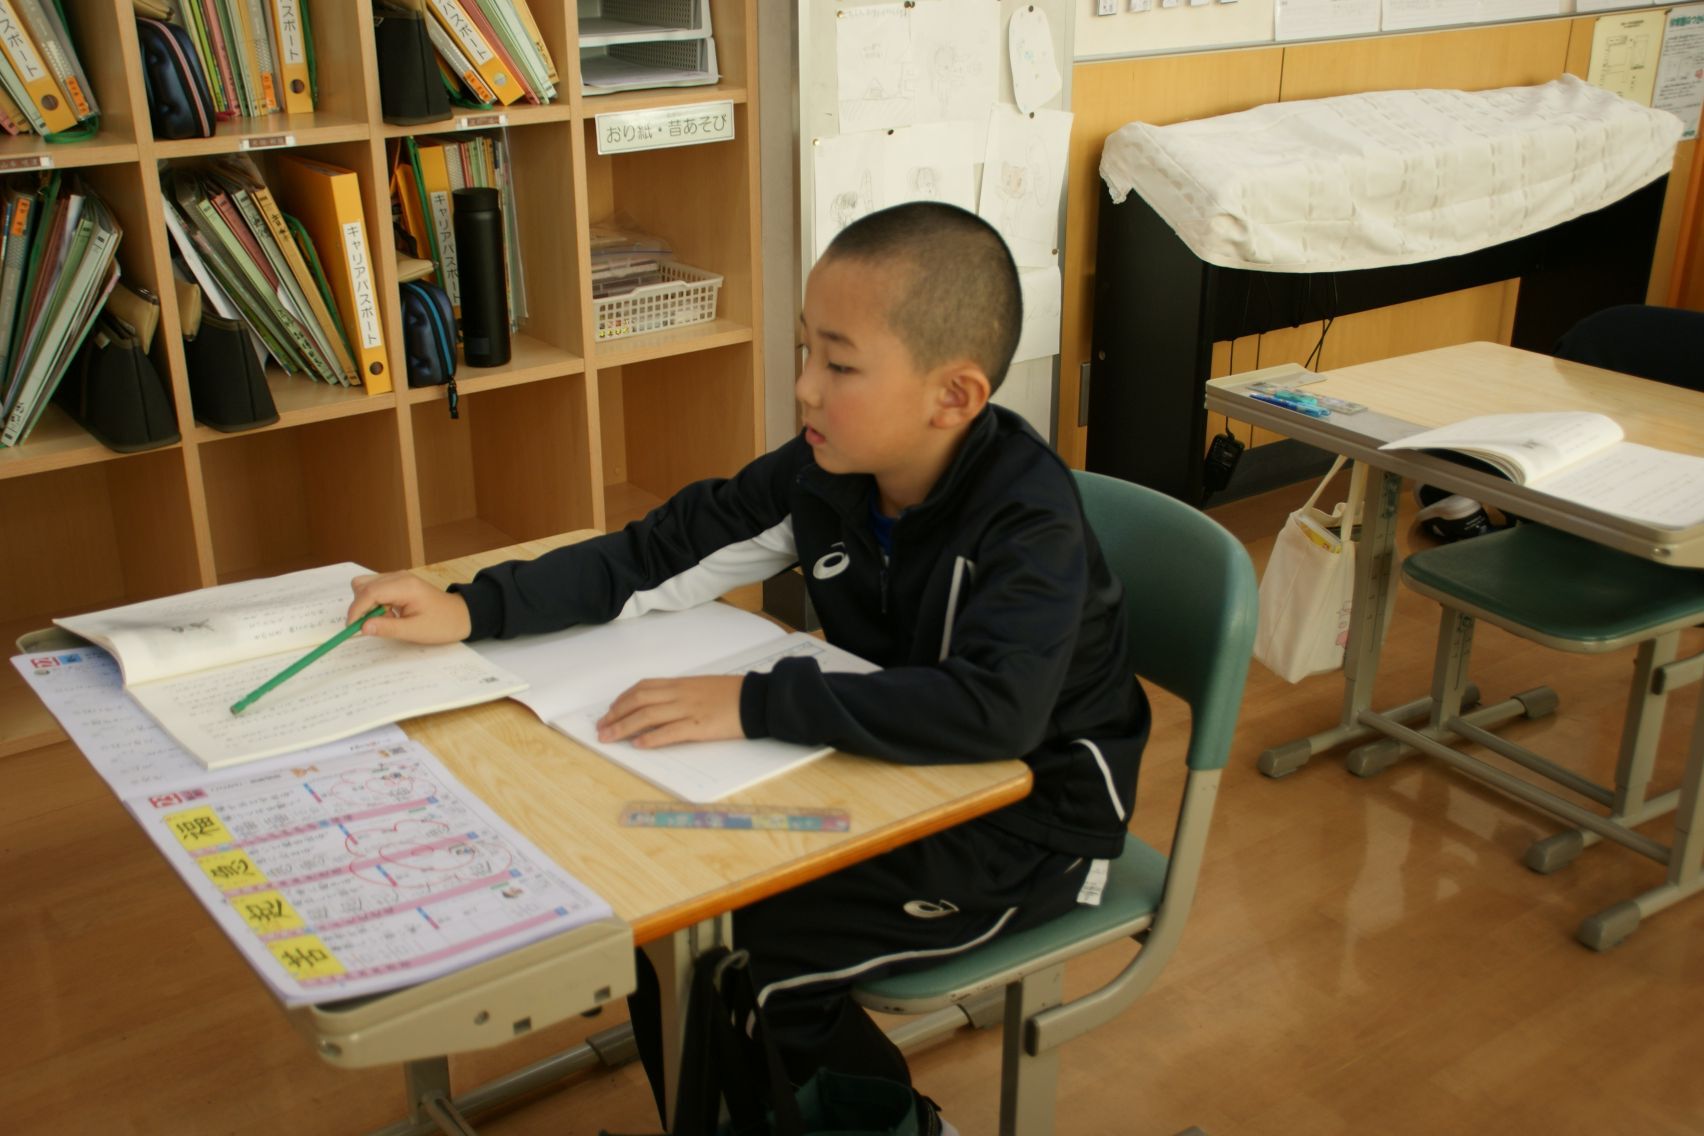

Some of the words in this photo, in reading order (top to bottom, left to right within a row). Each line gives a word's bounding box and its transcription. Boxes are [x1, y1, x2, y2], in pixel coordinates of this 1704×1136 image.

[279, 0, 299, 61] スポート
[439, 0, 488, 60] パスポート
[606, 114, 727, 144] おり紙・昔あそび
[347, 225, 377, 345] キャリアパスポート
